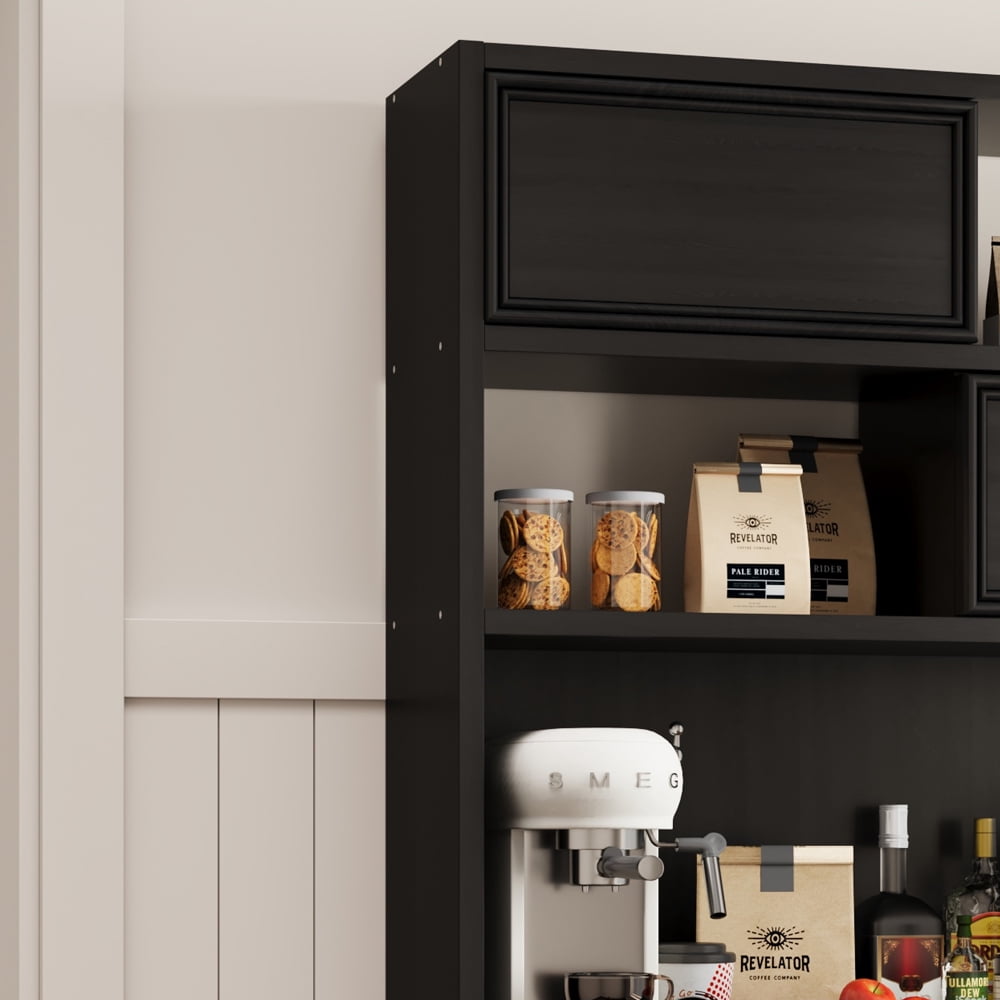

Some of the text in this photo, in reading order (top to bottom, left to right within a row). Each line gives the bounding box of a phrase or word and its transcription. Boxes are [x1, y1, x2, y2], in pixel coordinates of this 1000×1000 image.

[730, 532, 778, 545] REVELATOR
[731, 567, 780, 576] PALE RIDER
[814, 564, 842, 573] RIDER
[548, 772, 679, 790] SMEG
[740, 954, 810, 973] REVELATOR
[960, 988, 980, 998] DEW
